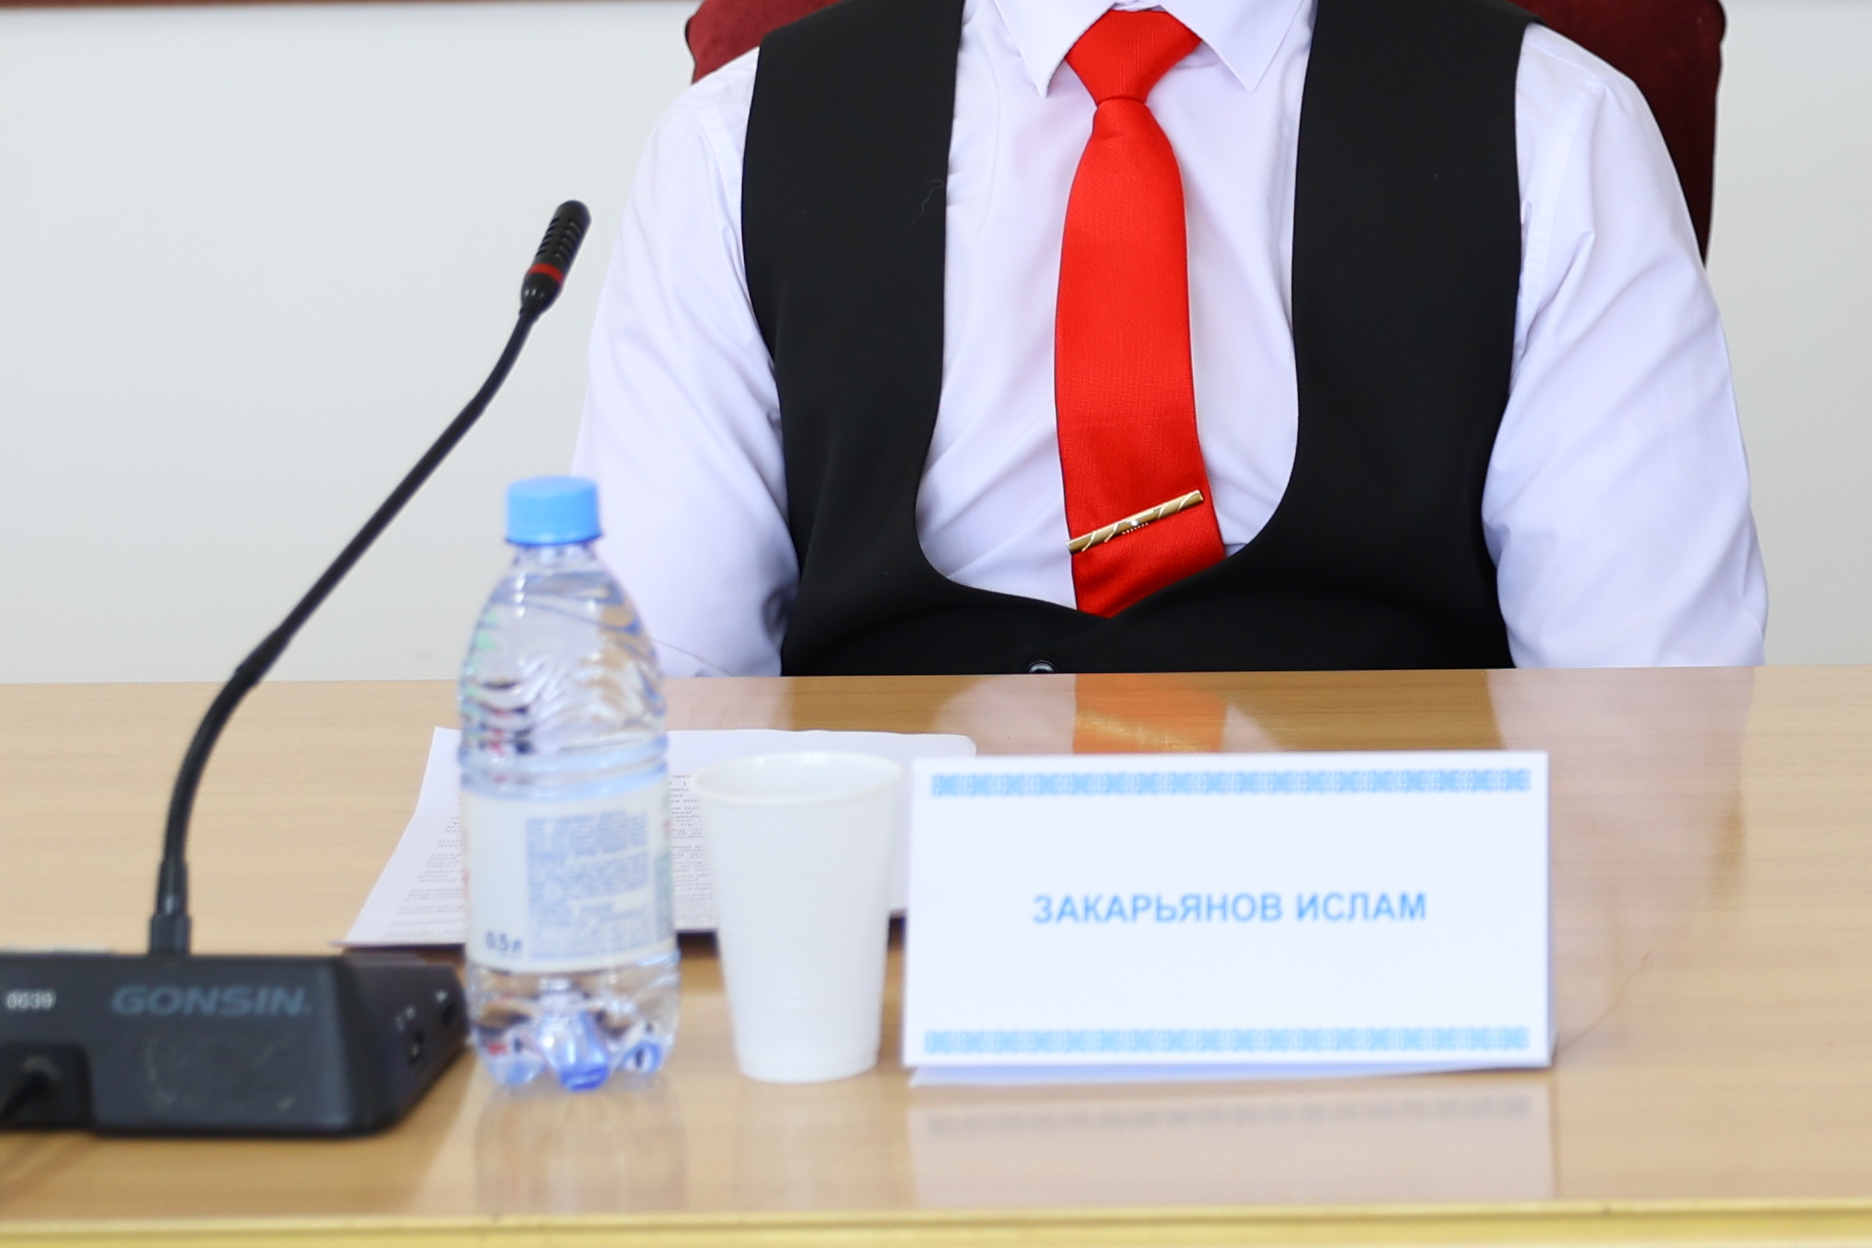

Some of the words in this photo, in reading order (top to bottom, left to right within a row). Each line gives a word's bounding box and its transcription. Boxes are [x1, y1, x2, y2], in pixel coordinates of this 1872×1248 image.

[1033, 893, 1283, 924] ЗАКАРЬЯНОВ
[1296, 892, 1426, 921] ИСЛАМ
[112, 986, 304, 1016] GONSIN
